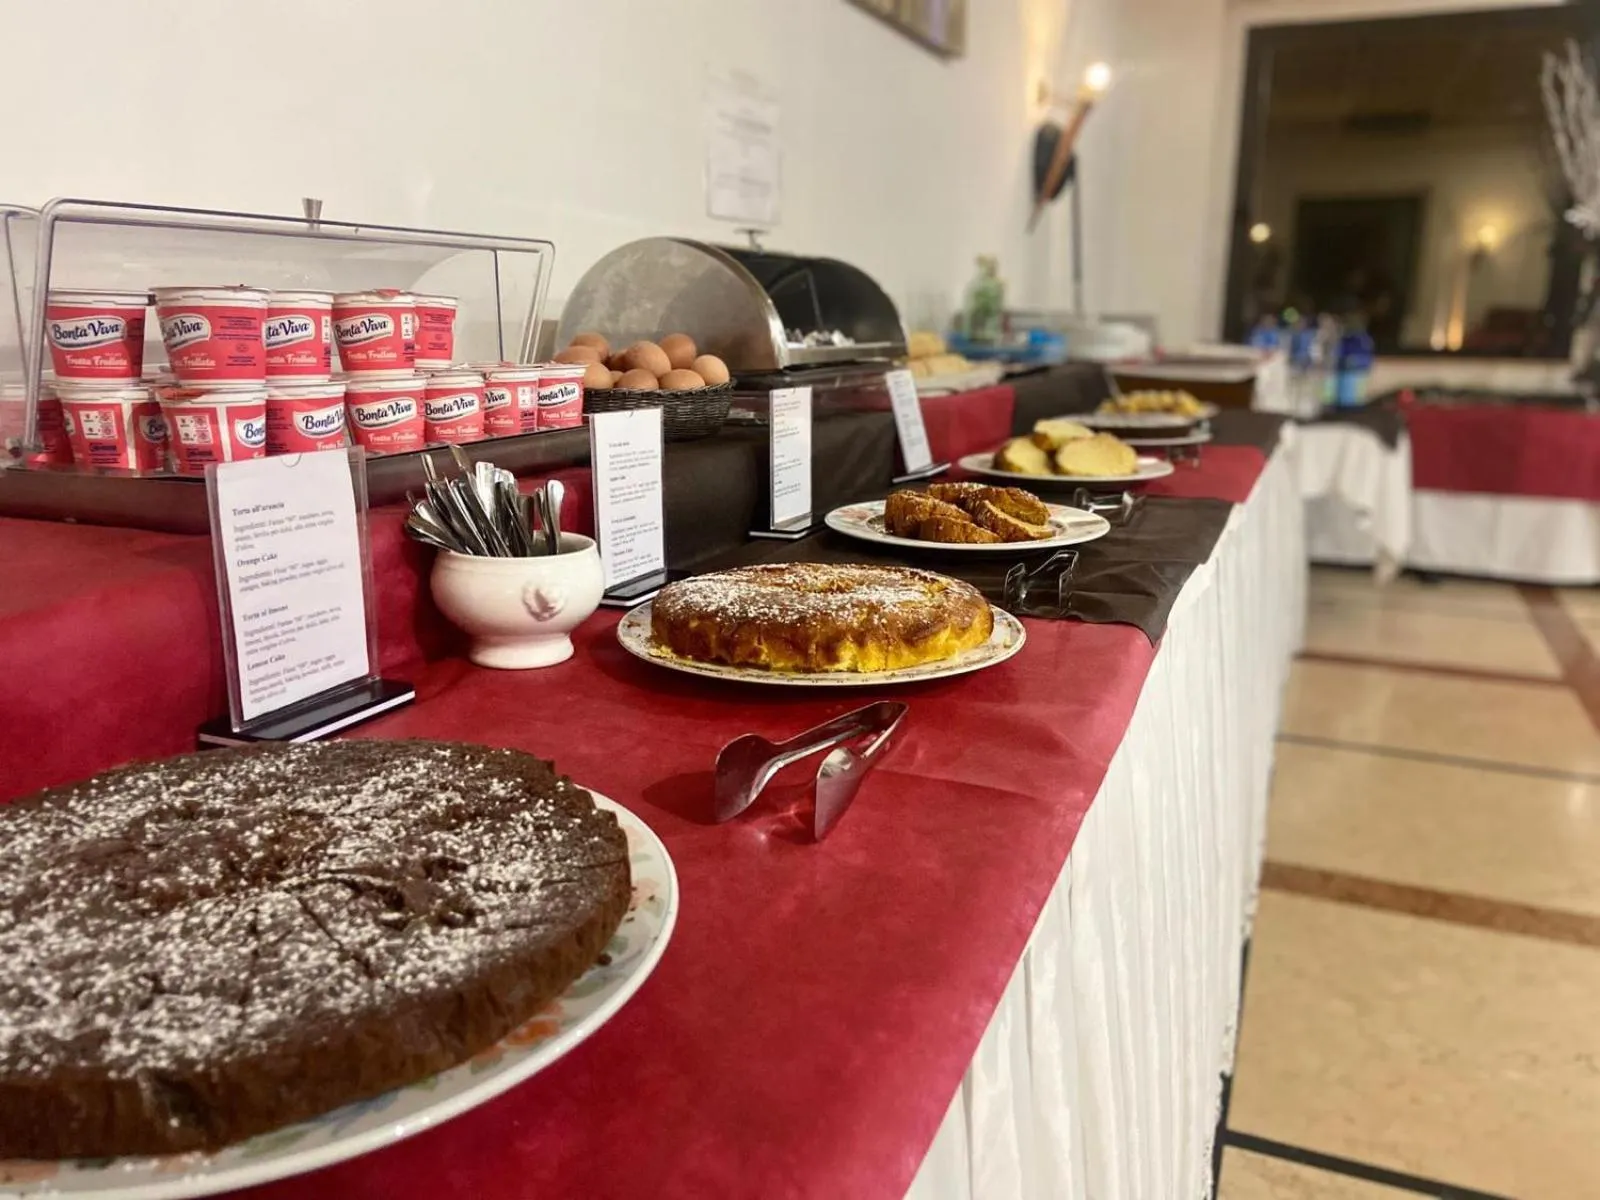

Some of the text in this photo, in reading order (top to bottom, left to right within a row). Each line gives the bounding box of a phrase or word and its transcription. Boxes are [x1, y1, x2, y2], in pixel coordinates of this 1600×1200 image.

[88, 321, 120, 336] Viva
[174, 319, 201, 336] Viva
[279, 319, 308, 335] Viva
[360, 318, 386, 333] Viva
[453, 397, 476, 410] Viva
[485, 391, 505, 404] Viva
[387, 402, 412, 416] Viva
[232, 508, 250, 516] Torta
[237, 553, 277, 567] Orange Cake
[247, 654, 286, 670] Lemon Cake
